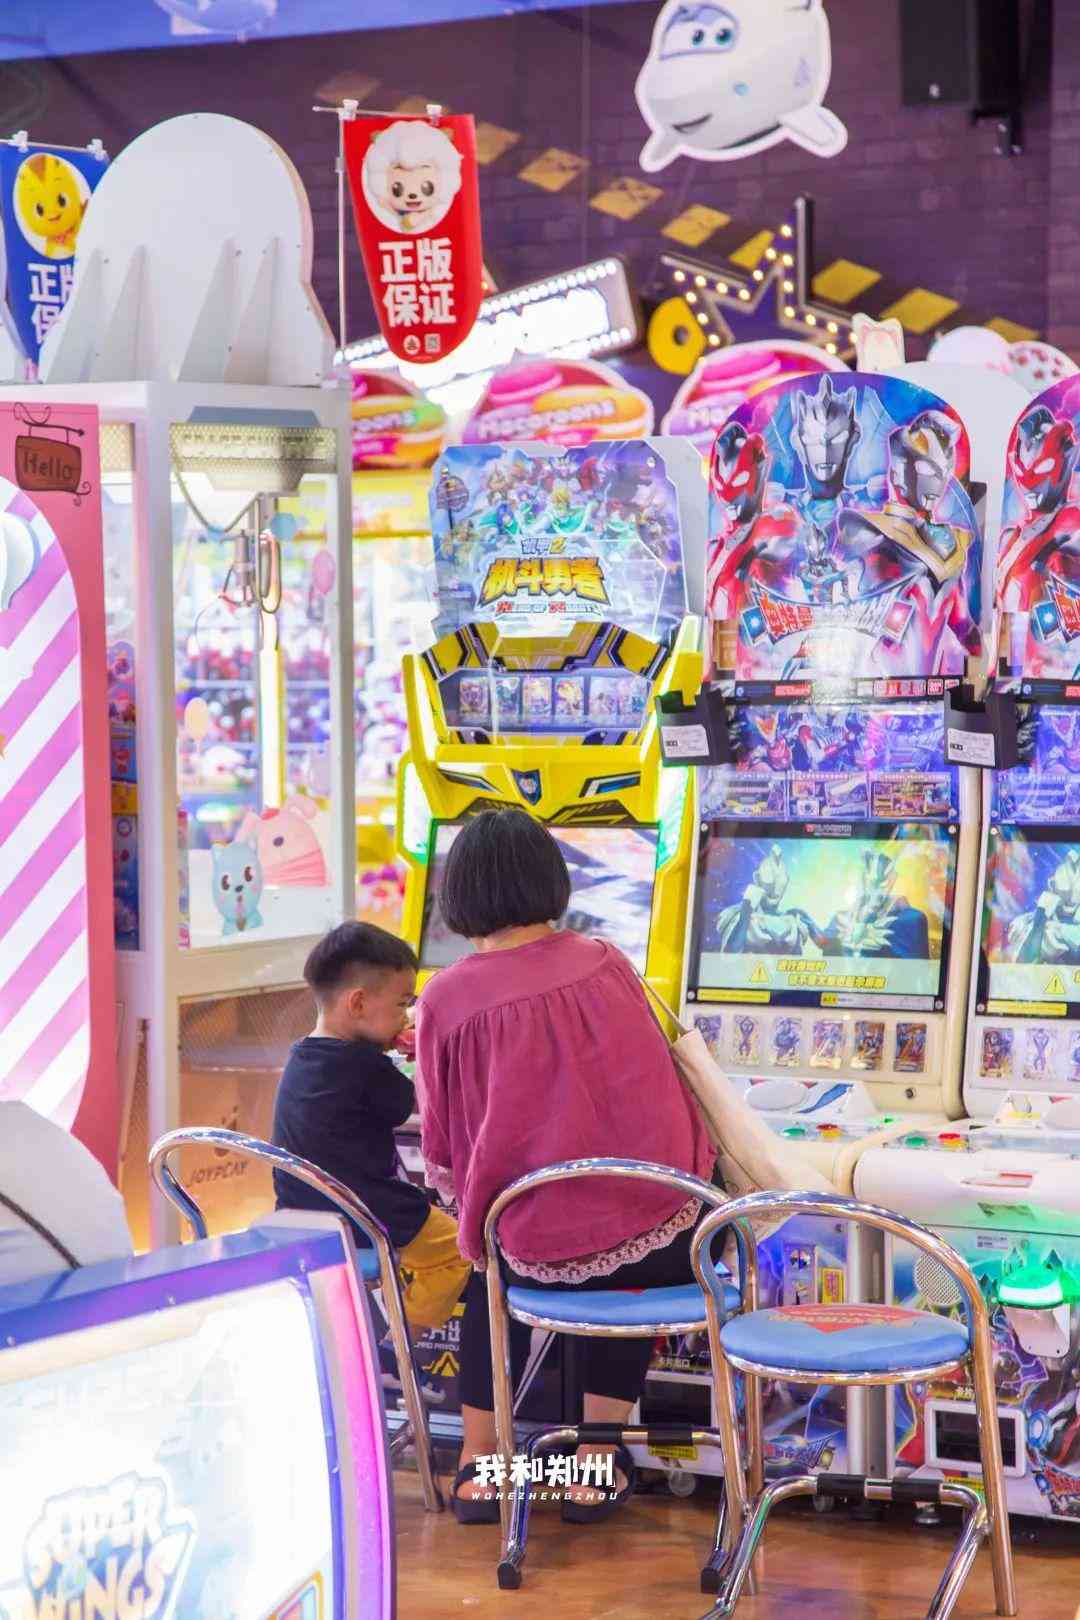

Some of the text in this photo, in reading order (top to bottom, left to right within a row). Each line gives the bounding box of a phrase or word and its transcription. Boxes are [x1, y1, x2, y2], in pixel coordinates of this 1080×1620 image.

[379, 237, 454, 282] 正版
[382, 283, 457, 328] 保证
[24, 451, 73, 480] Hello
